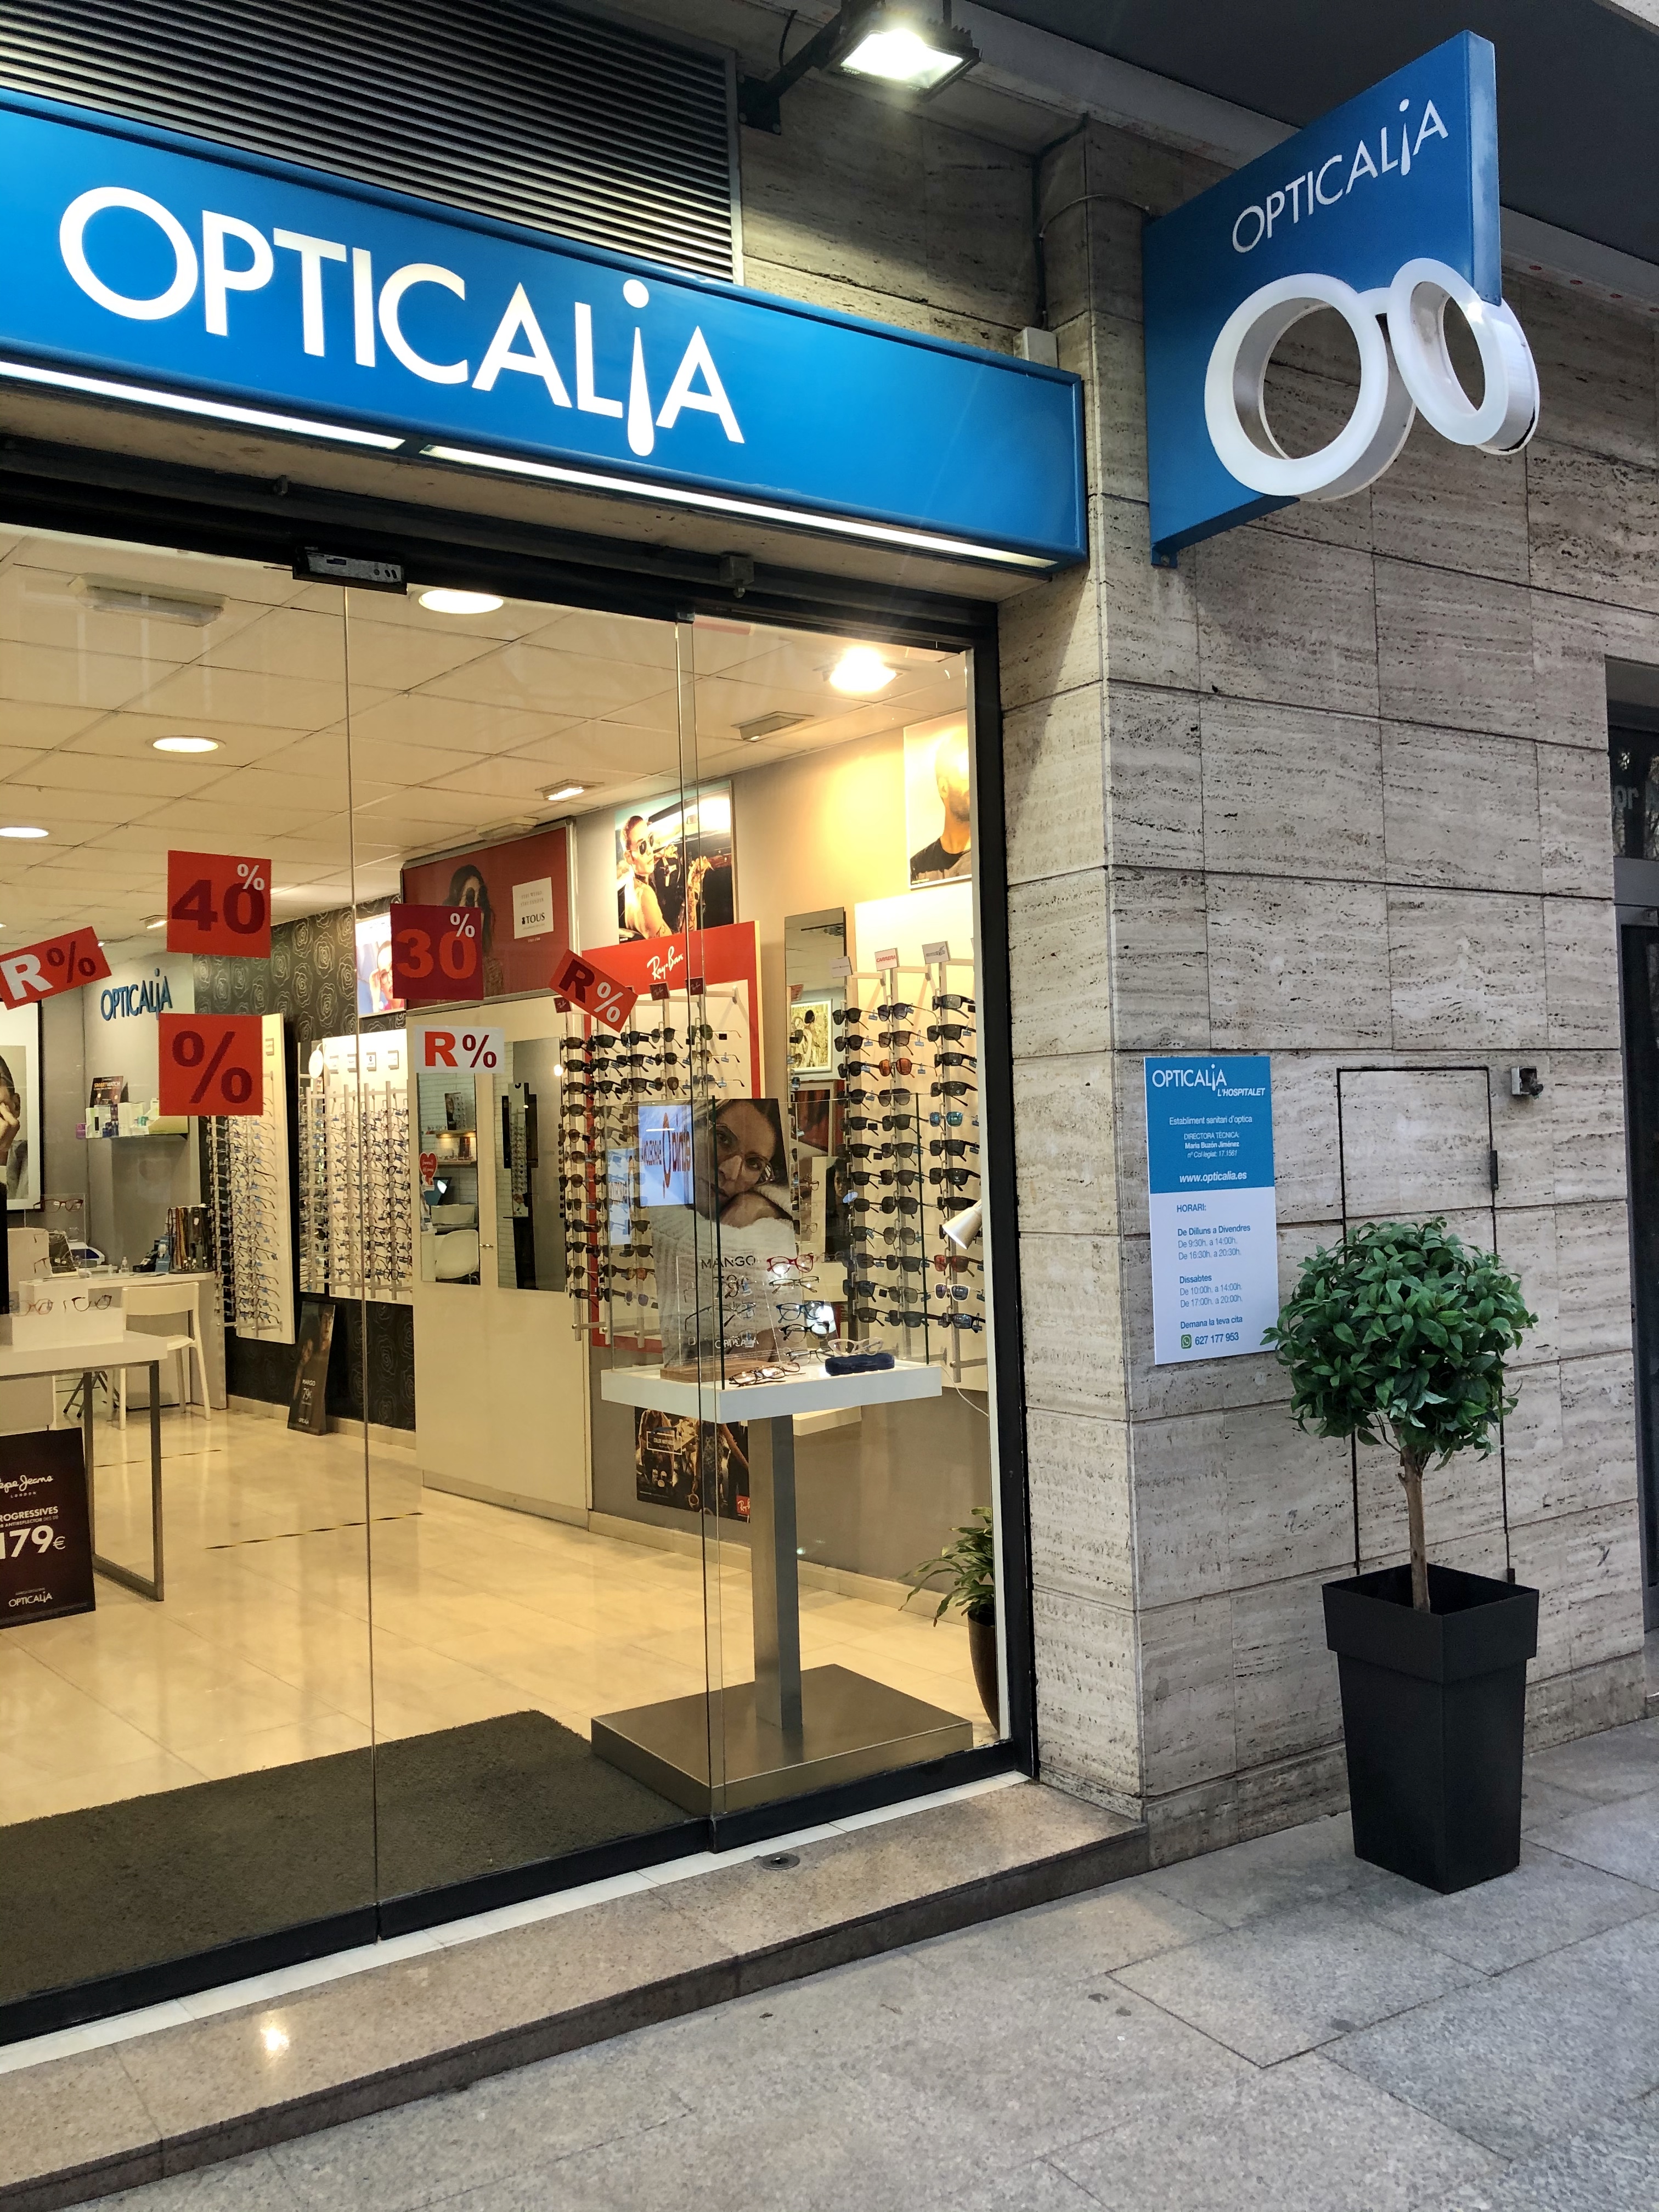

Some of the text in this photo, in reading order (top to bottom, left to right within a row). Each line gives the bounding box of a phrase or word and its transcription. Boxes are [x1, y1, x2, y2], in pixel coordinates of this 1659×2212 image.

[526, 912, 545, 924] TOUS
[876, 955, 896, 963] CARRERA
[1217, 1087, 1266, 1097] L'HOSPITALET
[1169, 1116, 1205, 1125] Establiment
[1206, 1115, 1227, 1124] sanitari
[1179, 1171, 1248, 1184] www.opticalia.es
[1176, 1203, 1207, 1213] HORARI:
[1177, 1228, 1187, 1237] De
[1188, 1227, 1211, 1236] Dilluns
[1218, 1224, 1251, 1234] Divendres
[1178, 1240, 1187, 1249] De
[1178, 1252, 1188, 1260] De
[701, 1255, 756, 1269] MANGO
[1179, 1274, 1212, 1284] Dissabtes
[1180, 1288, 1189, 1296] De
[1180, 1300, 1189, 1308] De
[1180, 1320, 1207, 1329] Demana
[1216, 1317, 1230, 1325] teva
[1231, 1315, 1243, 1323] cita
[1194, 1331, 1239, 1346] 627 177 953
[0, 1474, 54, 1493] epe Jeans
[0, 1506, 59, 1522] ROGRESSIVES
